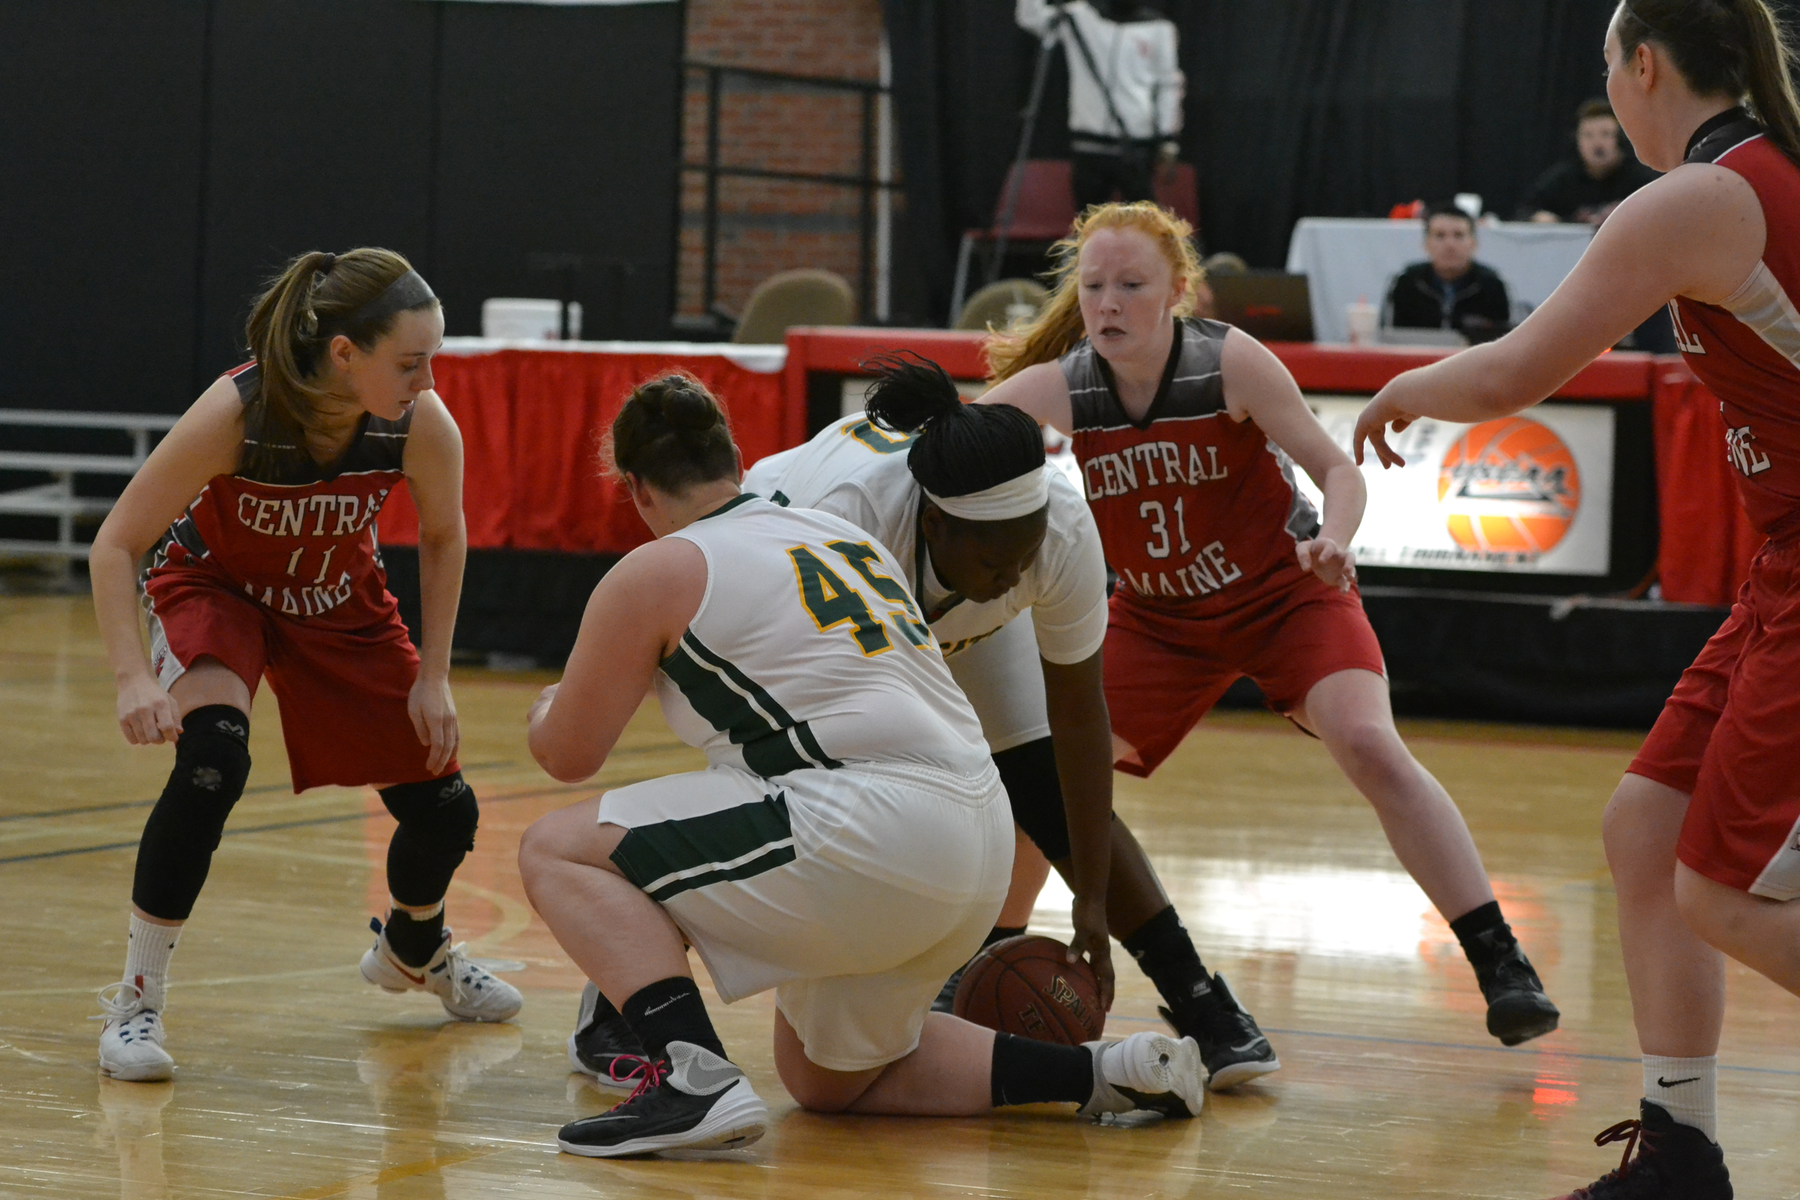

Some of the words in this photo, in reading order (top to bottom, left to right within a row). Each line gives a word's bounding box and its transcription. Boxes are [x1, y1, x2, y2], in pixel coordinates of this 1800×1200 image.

[1084, 441, 1228, 501] CENTRAL
[238, 489, 389, 536] CENTRA
[1139, 496, 1192, 559] 31
[286, 544, 337, 584] 11
[1124, 540, 1243, 597] MAINE
[785, 539, 936, 658] 45
[1043, 974, 1099, 1039] SPALD
